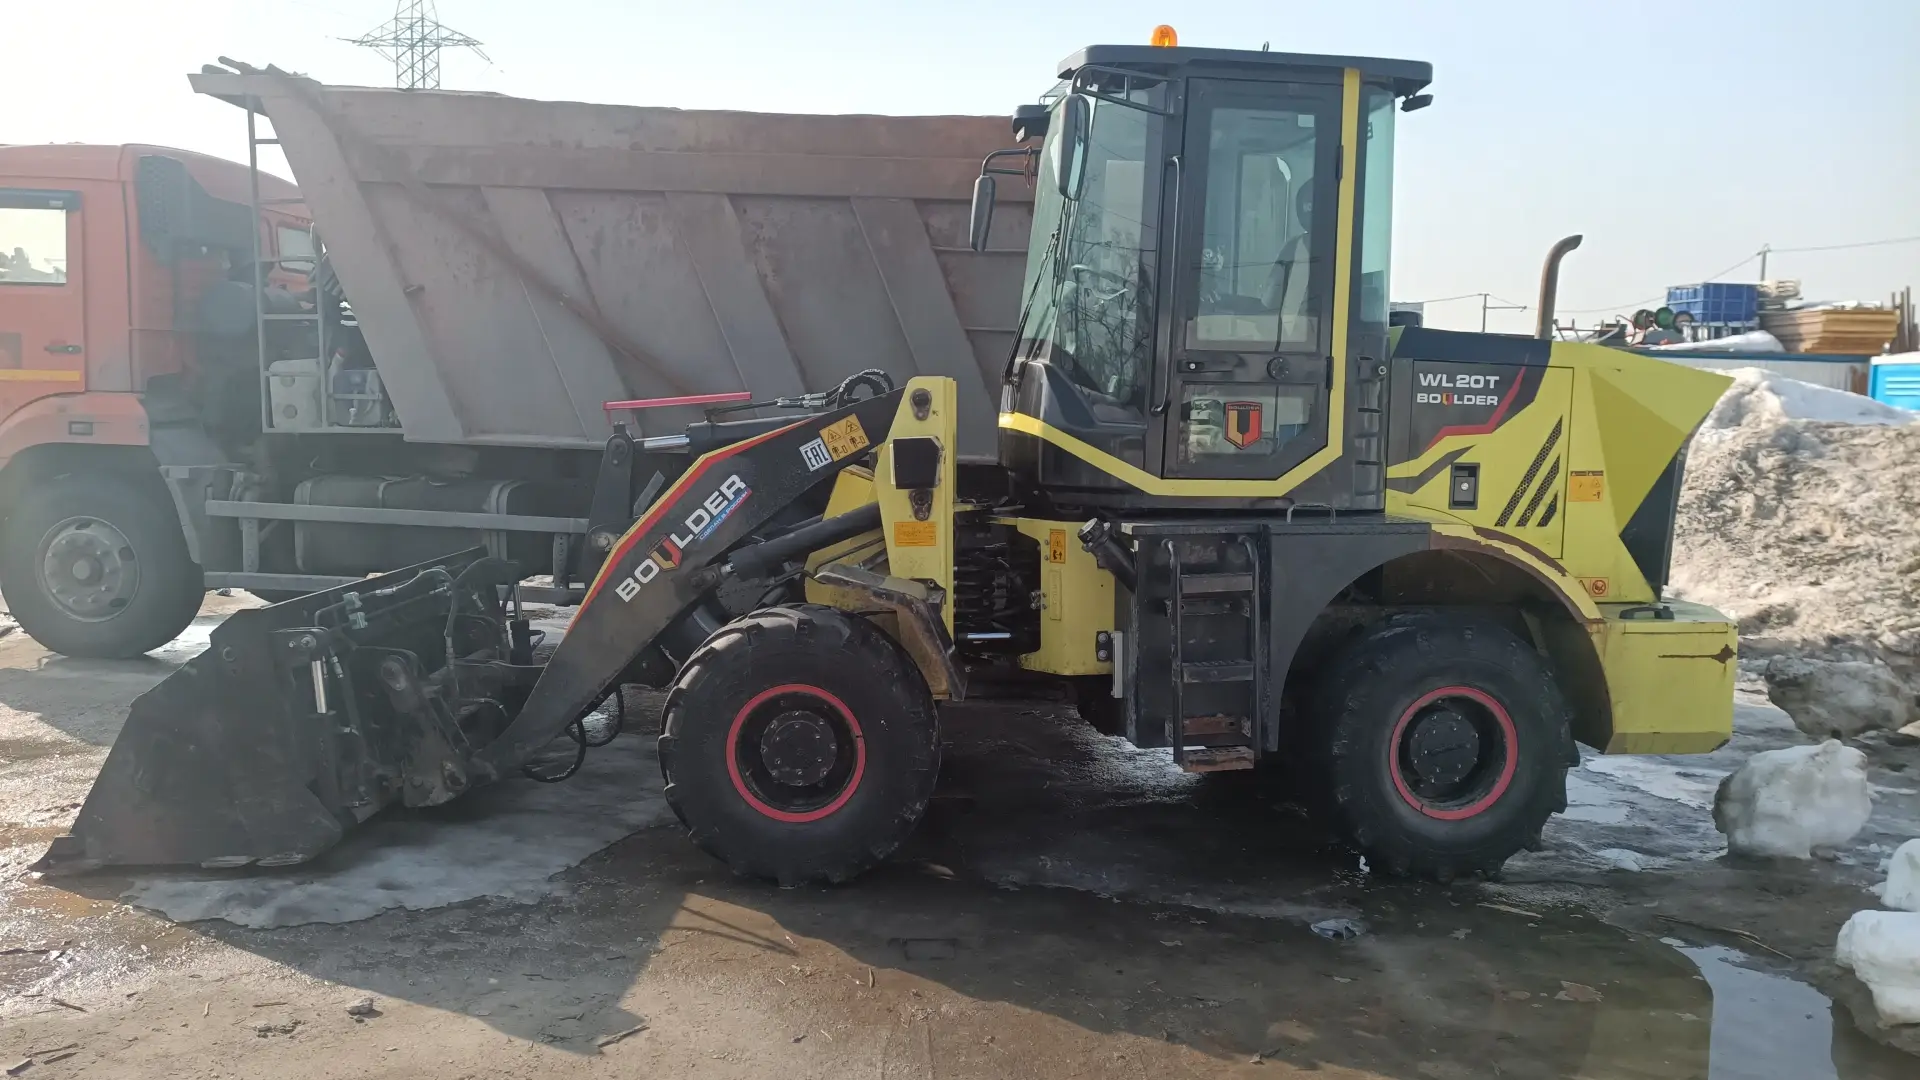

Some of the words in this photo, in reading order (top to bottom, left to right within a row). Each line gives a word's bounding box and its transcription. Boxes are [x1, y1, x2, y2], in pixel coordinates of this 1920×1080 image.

[1418, 372, 1500, 389] WL20T
[1416, 392, 1499, 406] BOULDER
[615, 474, 746, 602] BOULDER
